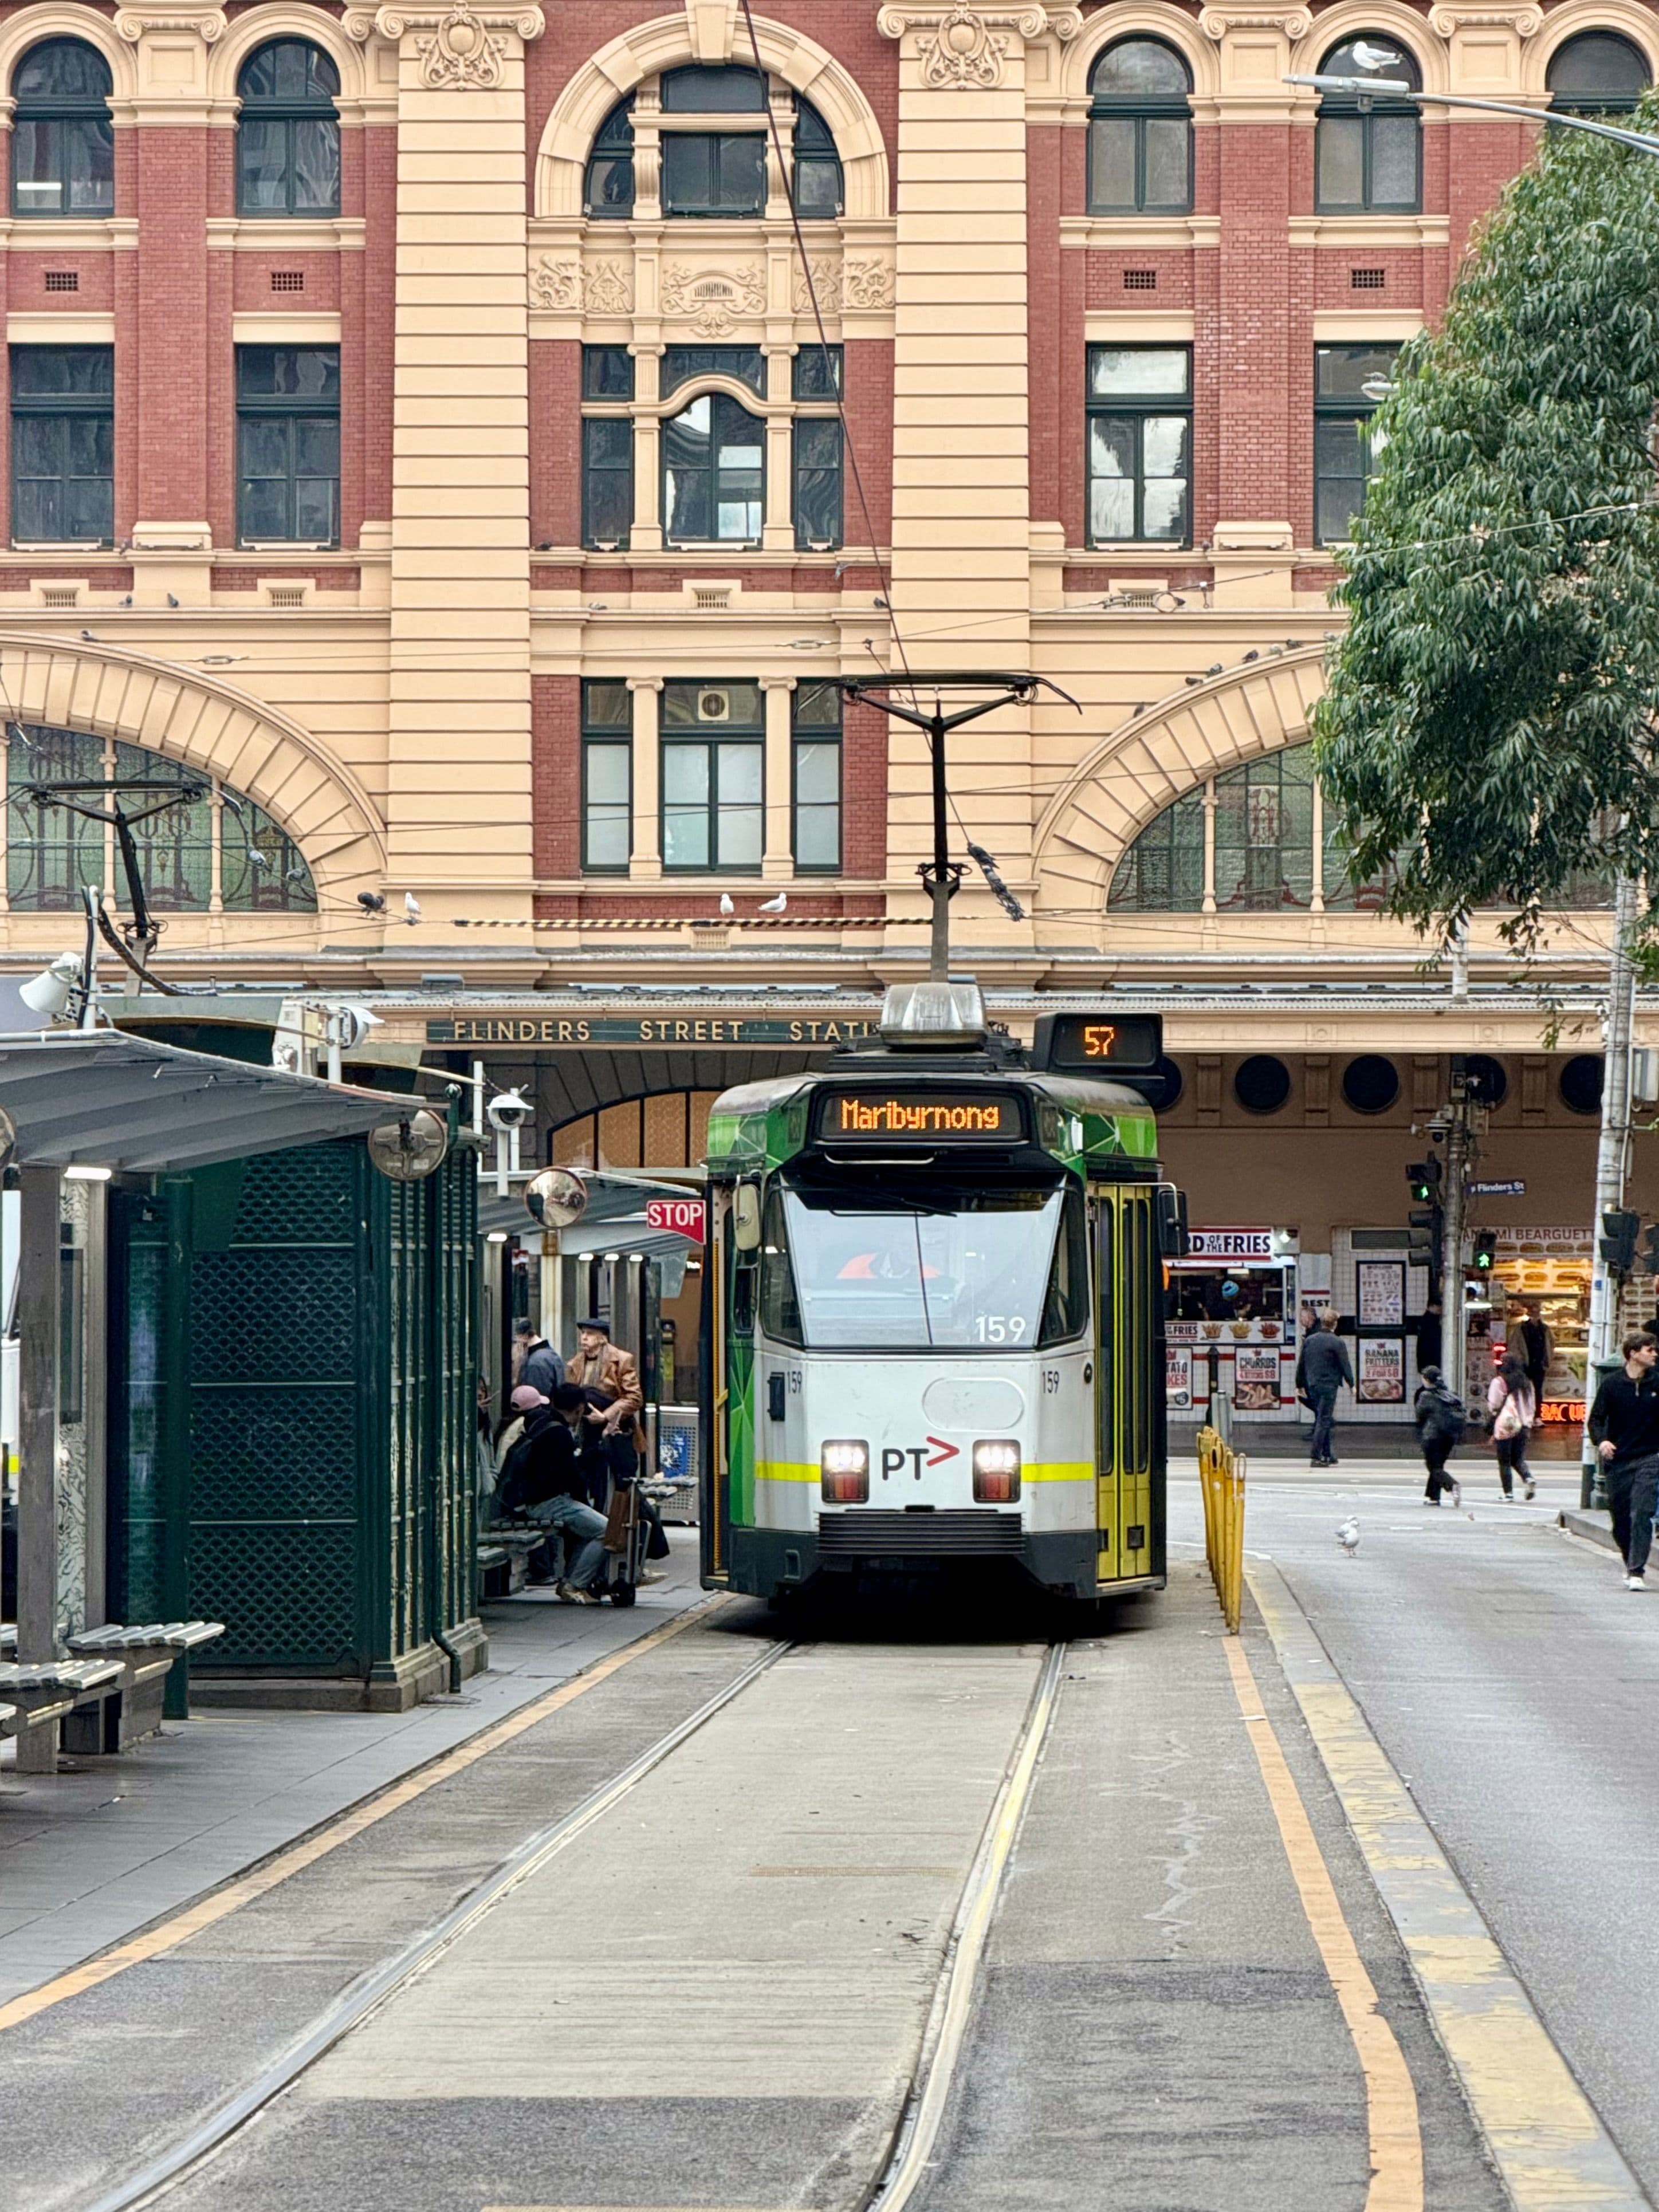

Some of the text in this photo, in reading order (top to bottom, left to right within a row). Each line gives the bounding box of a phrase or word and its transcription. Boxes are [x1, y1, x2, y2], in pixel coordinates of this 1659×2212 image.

[454, 1021, 880, 1041] FLINDERS STREET STATI
[1084, 1026, 1115, 1056] 57
[842, 1099, 999, 1129] Maribyrnong
[1477, 1182, 1524, 1192] Flinders St
[649, 1204, 702, 1226] STOP
[1207, 1244, 1222, 1253] THE
[1209, 1235, 1220, 1243] OF
[1224, 1235, 1271, 1253] FRIES
[975, 1317, 1026, 1343] 159
[1174, 1326, 1198, 1335] FRIES
[1240, 1357, 1276, 1368] CHURROS
[787, 1371, 803, 1394] 159
[1042, 1371, 1059, 1394] 159
